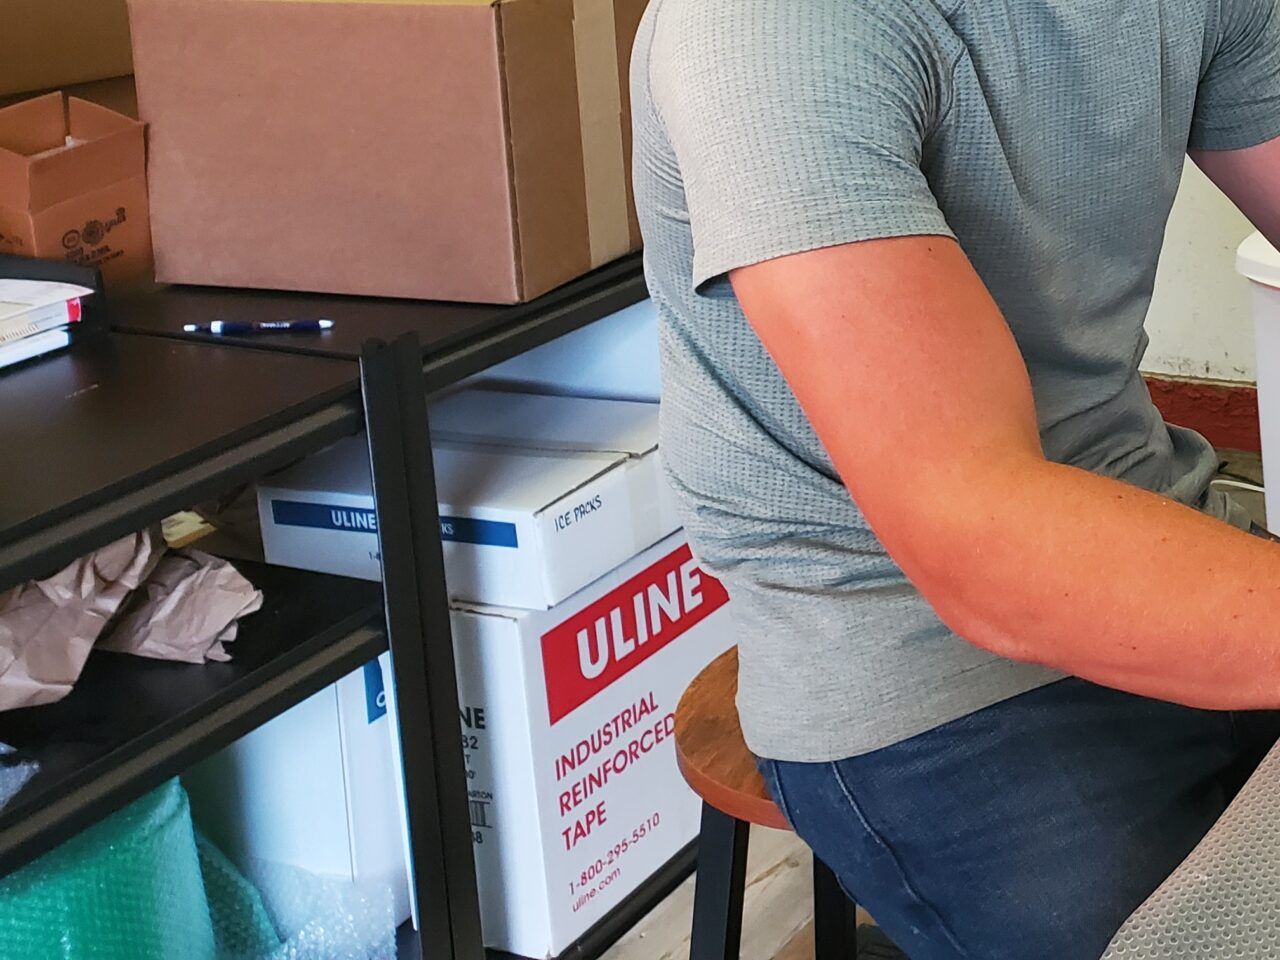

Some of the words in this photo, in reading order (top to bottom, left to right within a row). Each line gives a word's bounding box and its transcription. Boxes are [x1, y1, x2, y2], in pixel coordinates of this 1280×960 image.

[331, 509, 377, 530] ULINE
[554, 509, 572, 533] ICE
[573, 494, 602, 523] PACKS
[577, 560, 704, 680] ULINE
[555, 691, 659, 781] INDUSTRIAL
[559, 712, 676, 817] REINFORCED
[562, 801, 607, 851] TAPE
[569, 812, 660, 895] 1-800-295-5510
[572, 867, 621, 912] uline.com
